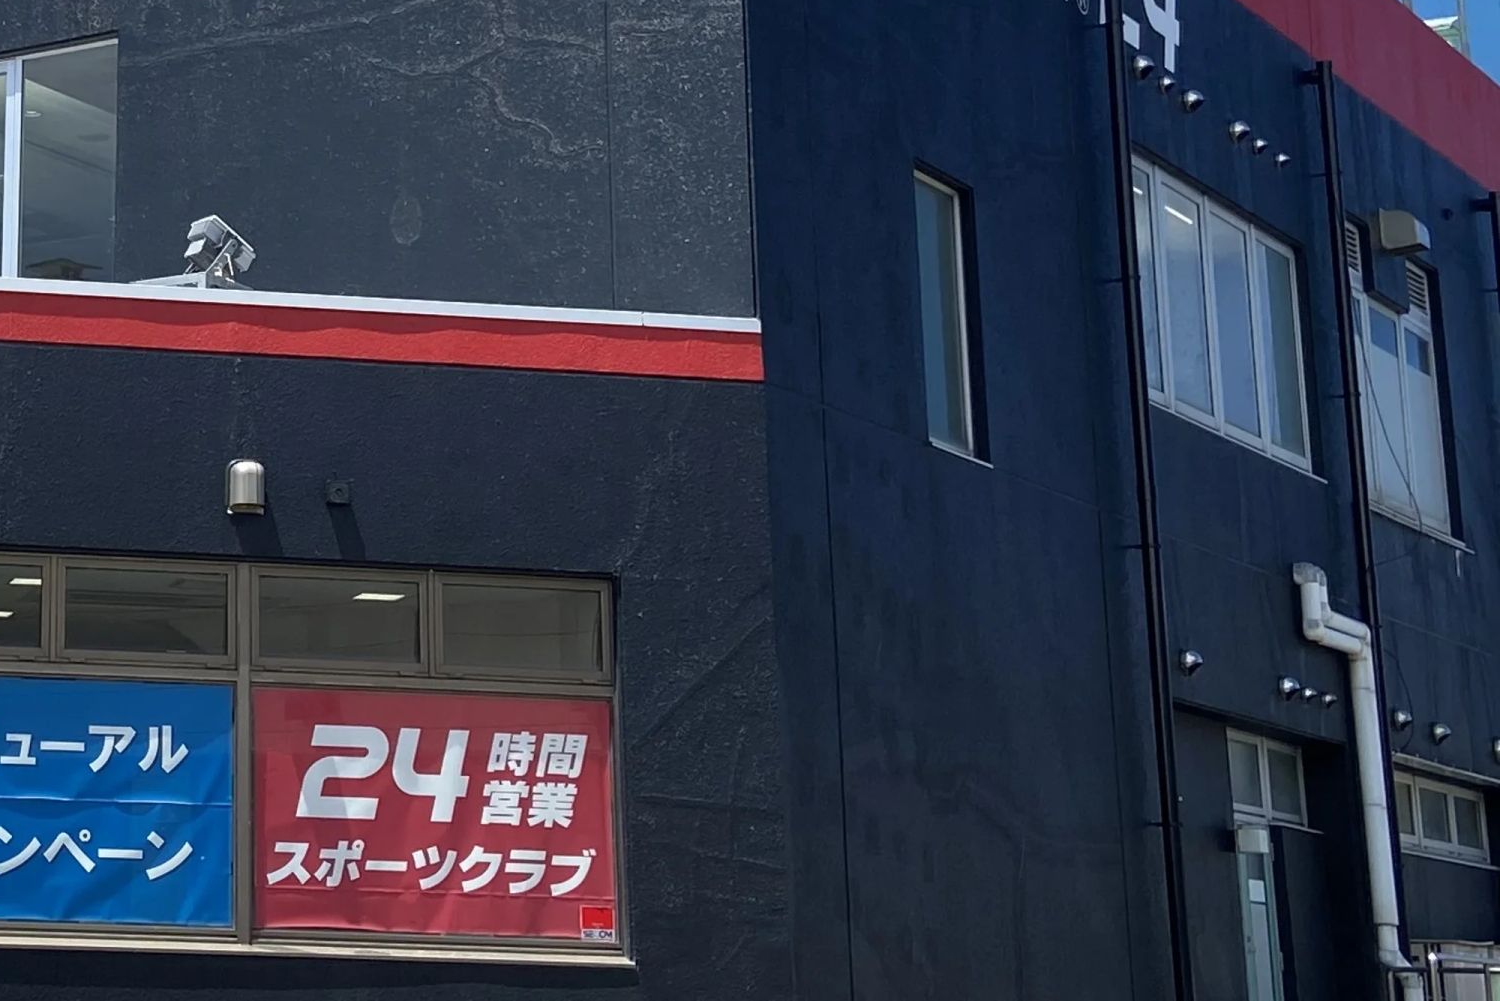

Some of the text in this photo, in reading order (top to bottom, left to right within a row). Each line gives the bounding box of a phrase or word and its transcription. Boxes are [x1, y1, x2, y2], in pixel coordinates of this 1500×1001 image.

[266, 840, 596, 897] スポーツクラブ
